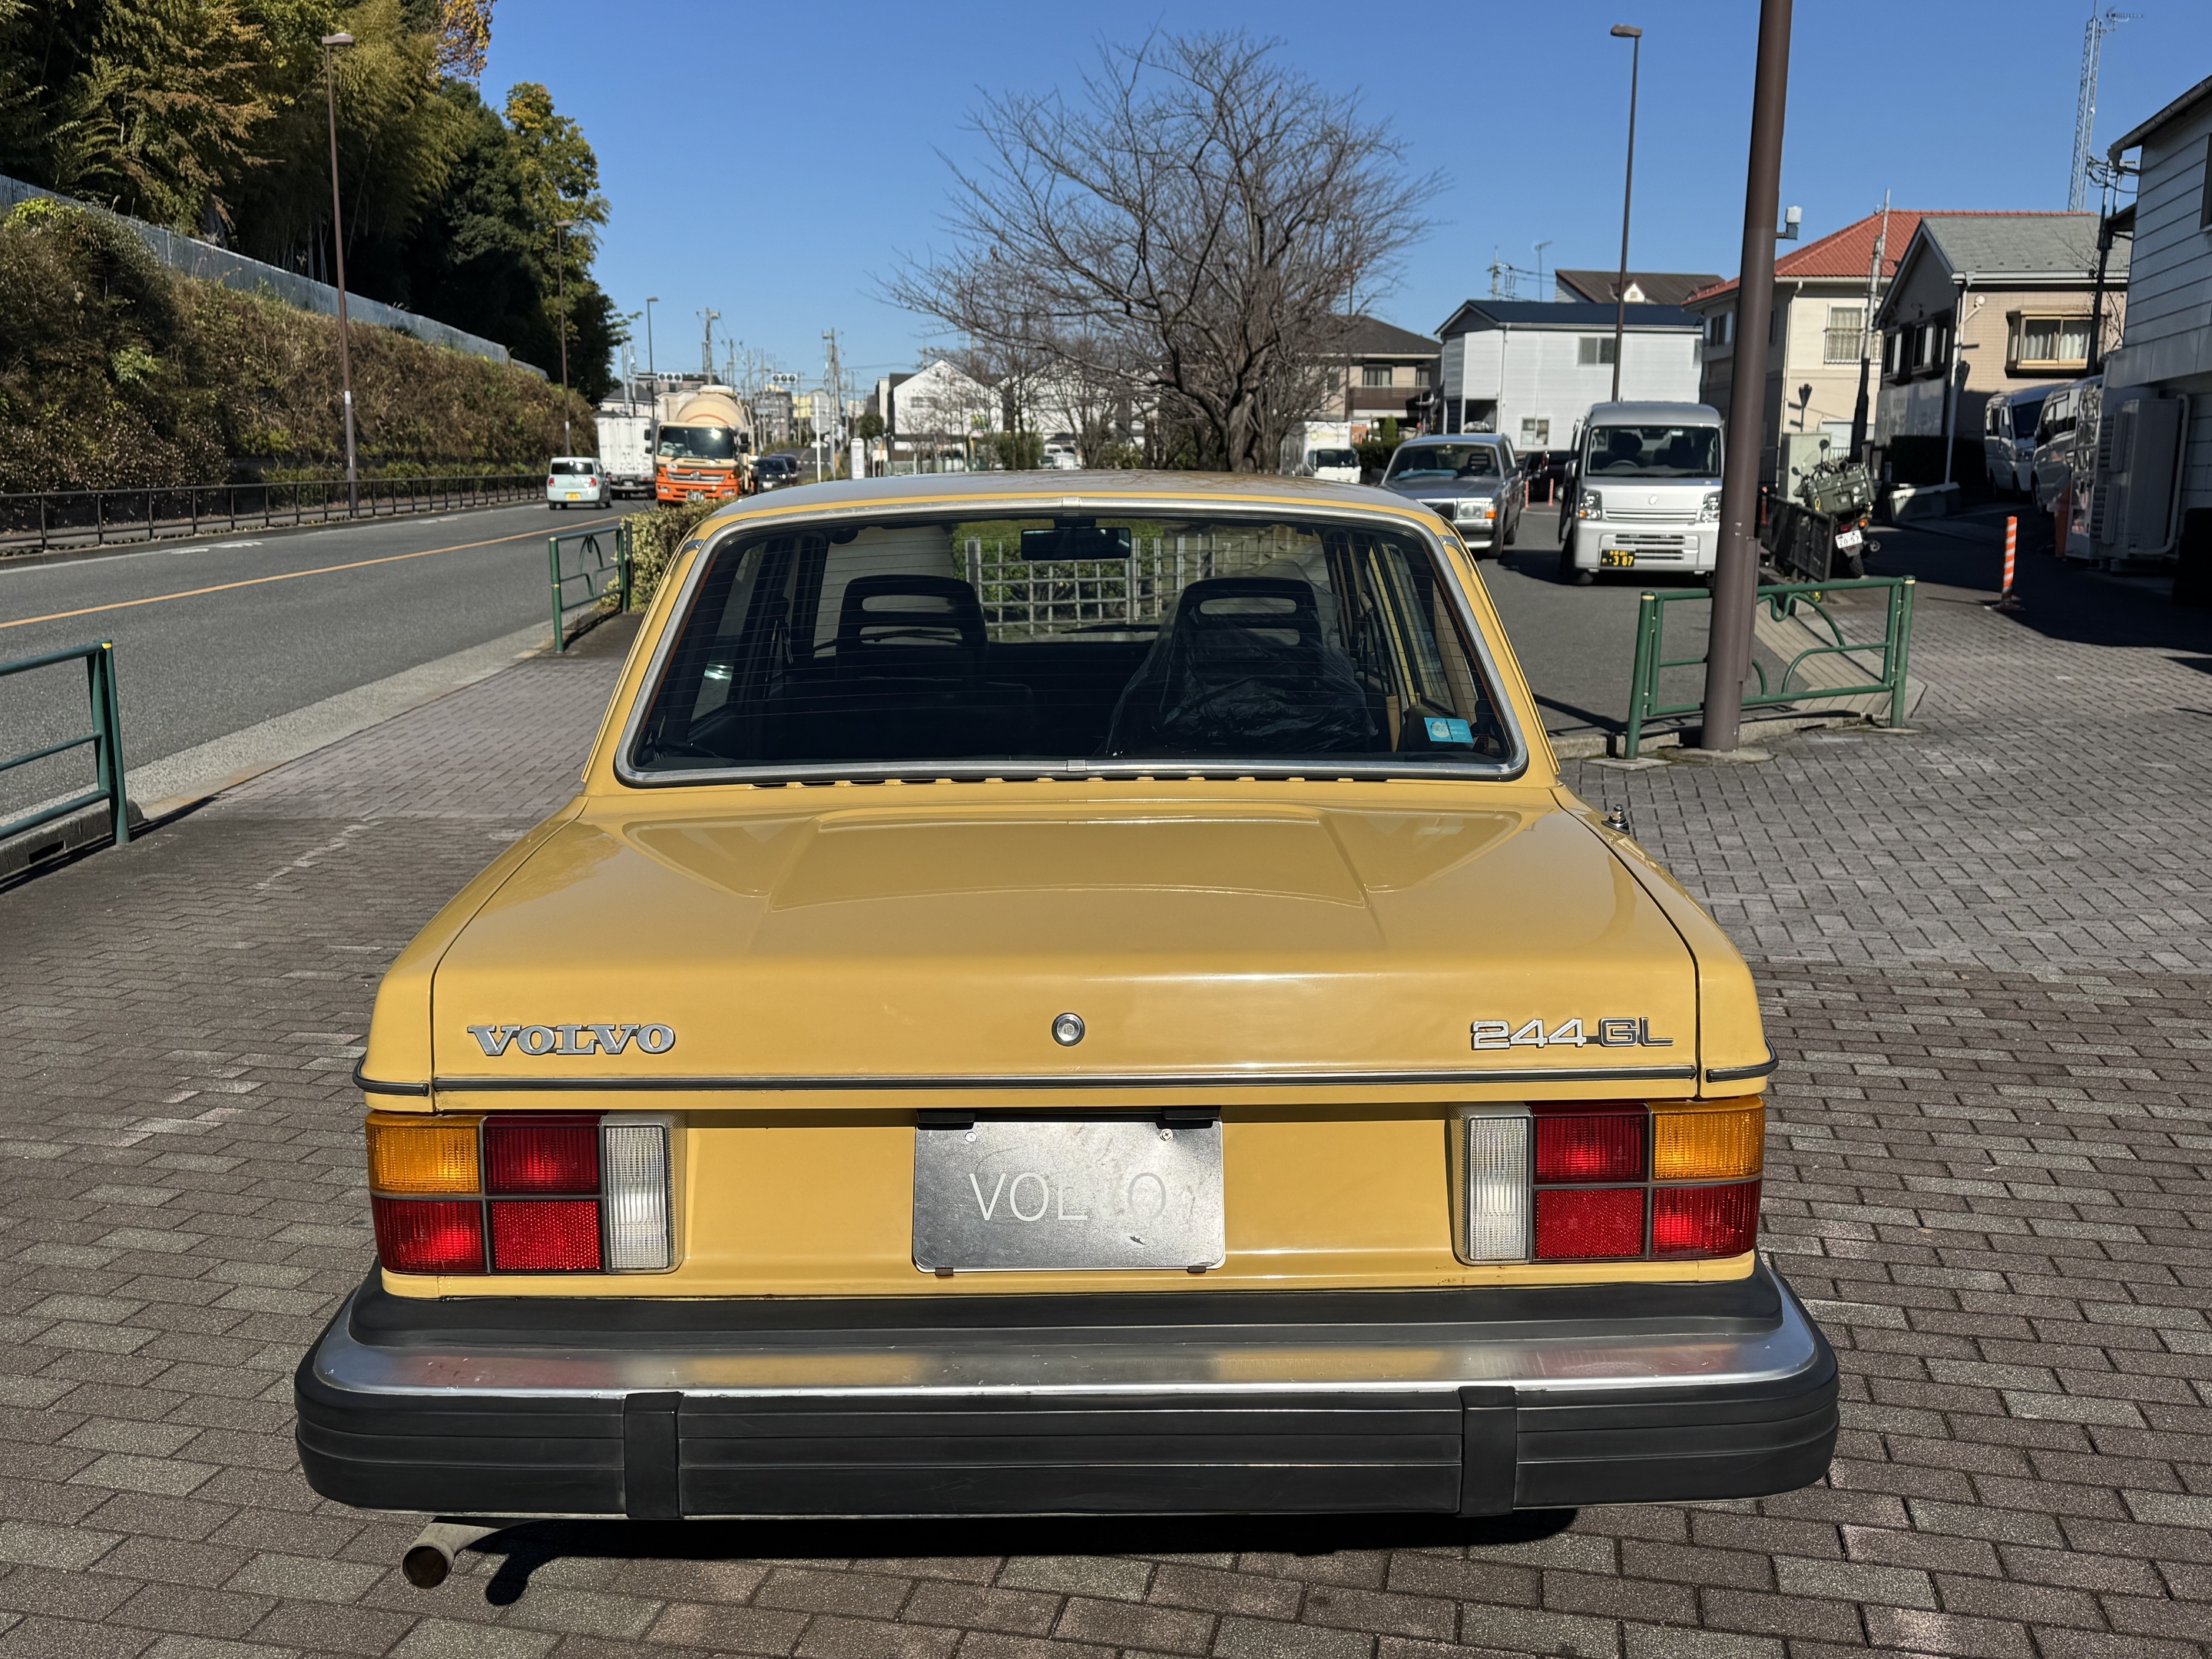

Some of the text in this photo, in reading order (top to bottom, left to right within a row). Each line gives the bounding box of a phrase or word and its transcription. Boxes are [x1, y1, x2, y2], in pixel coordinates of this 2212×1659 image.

[467, 1024, 676, 1056] VOLVO
[1470, 1017, 1674, 1051] 244 GL
[969, 1172, 1167, 1222] VOLVO
